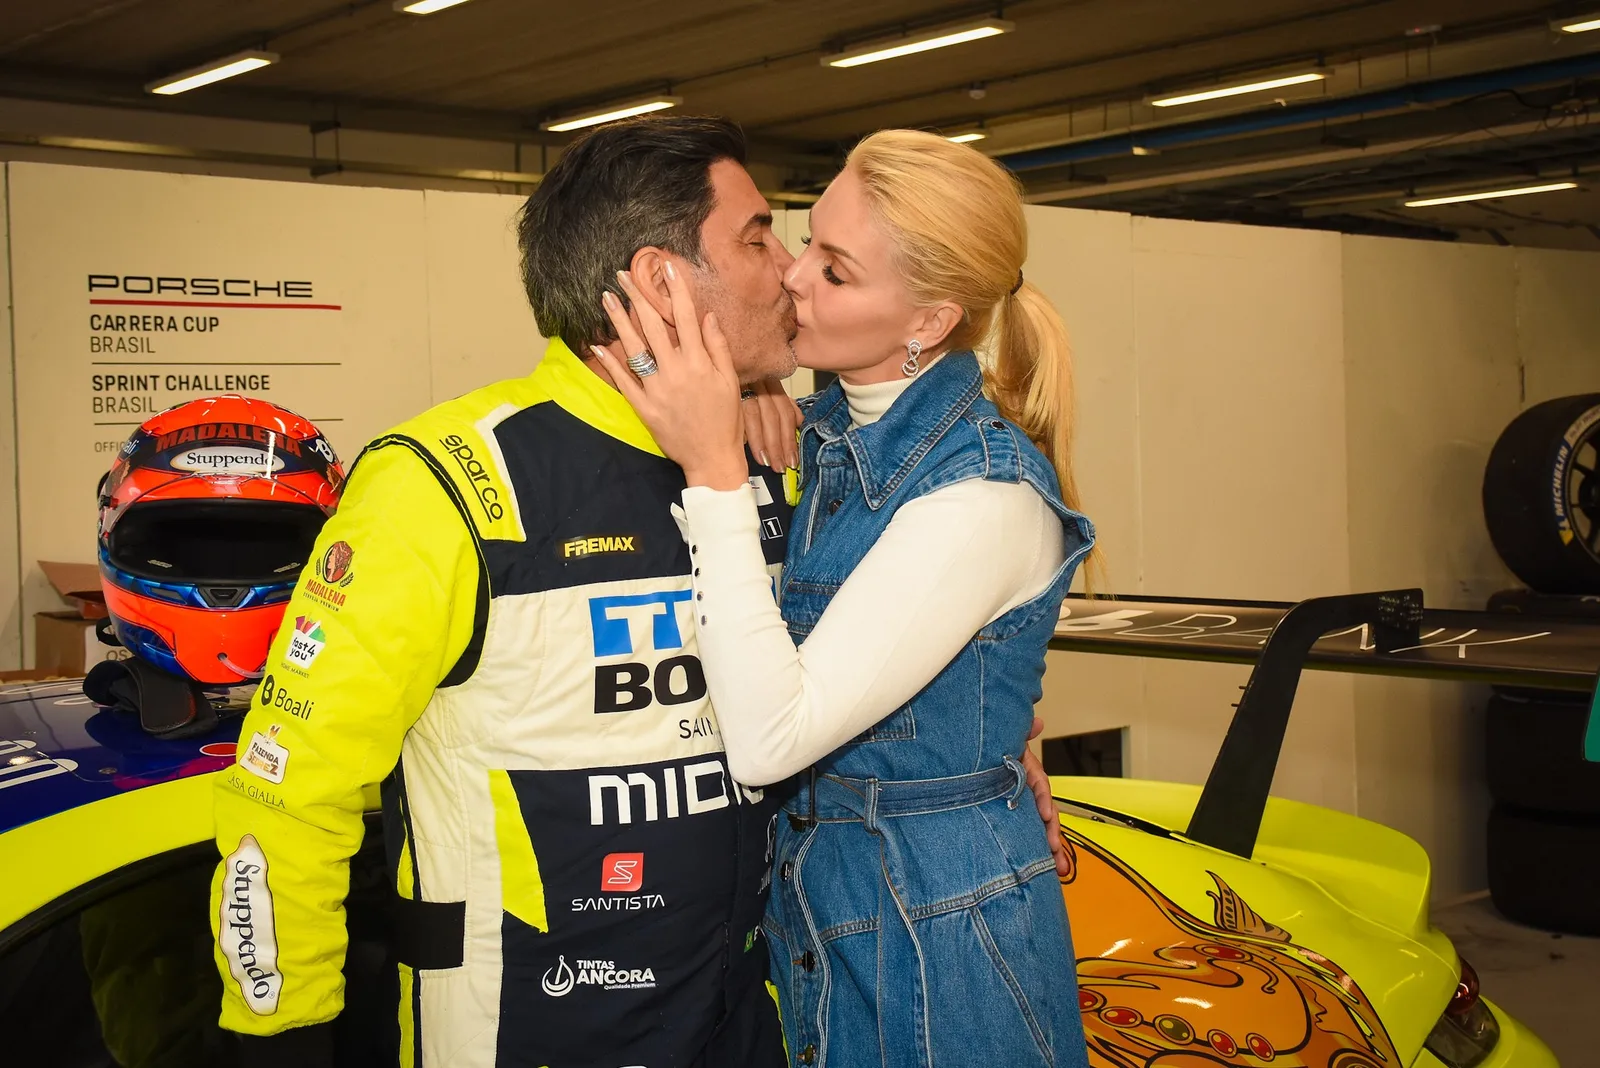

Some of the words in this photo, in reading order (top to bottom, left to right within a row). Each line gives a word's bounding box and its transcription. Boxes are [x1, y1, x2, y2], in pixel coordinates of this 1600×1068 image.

[88, 274, 313, 298] PORSCHE
[90, 314, 178, 332] CARRERA
[183, 317, 220, 332] CUP
[90, 336, 156, 353] BRASIL
[92, 375, 160, 391] SPRINT
[165, 375, 270, 391] CHALLENGE
[92, 397, 157, 413] BRASIL
[155, 424, 302, 458] MADALENA
[186, 452, 276, 466] Stuppendo
[439, 434, 504, 523] sparco
[1552, 446, 1570, 517] MICHELIN
[564, 536, 635, 558] FREMAX
[304, 578, 347, 607] MADALENA
[289, 648, 308, 661] you
[593, 654, 708, 714] BO
[274, 687, 315, 721] Boali
[251, 741, 280, 766] FAZENDA
[247, 784, 286, 809] GIALLA
[571, 894, 666, 912] SANTISTA
[228, 859, 275, 999] Stuppendo
[576, 960, 616, 970] TINTAS
[576, 967, 656, 984] ANCORA
